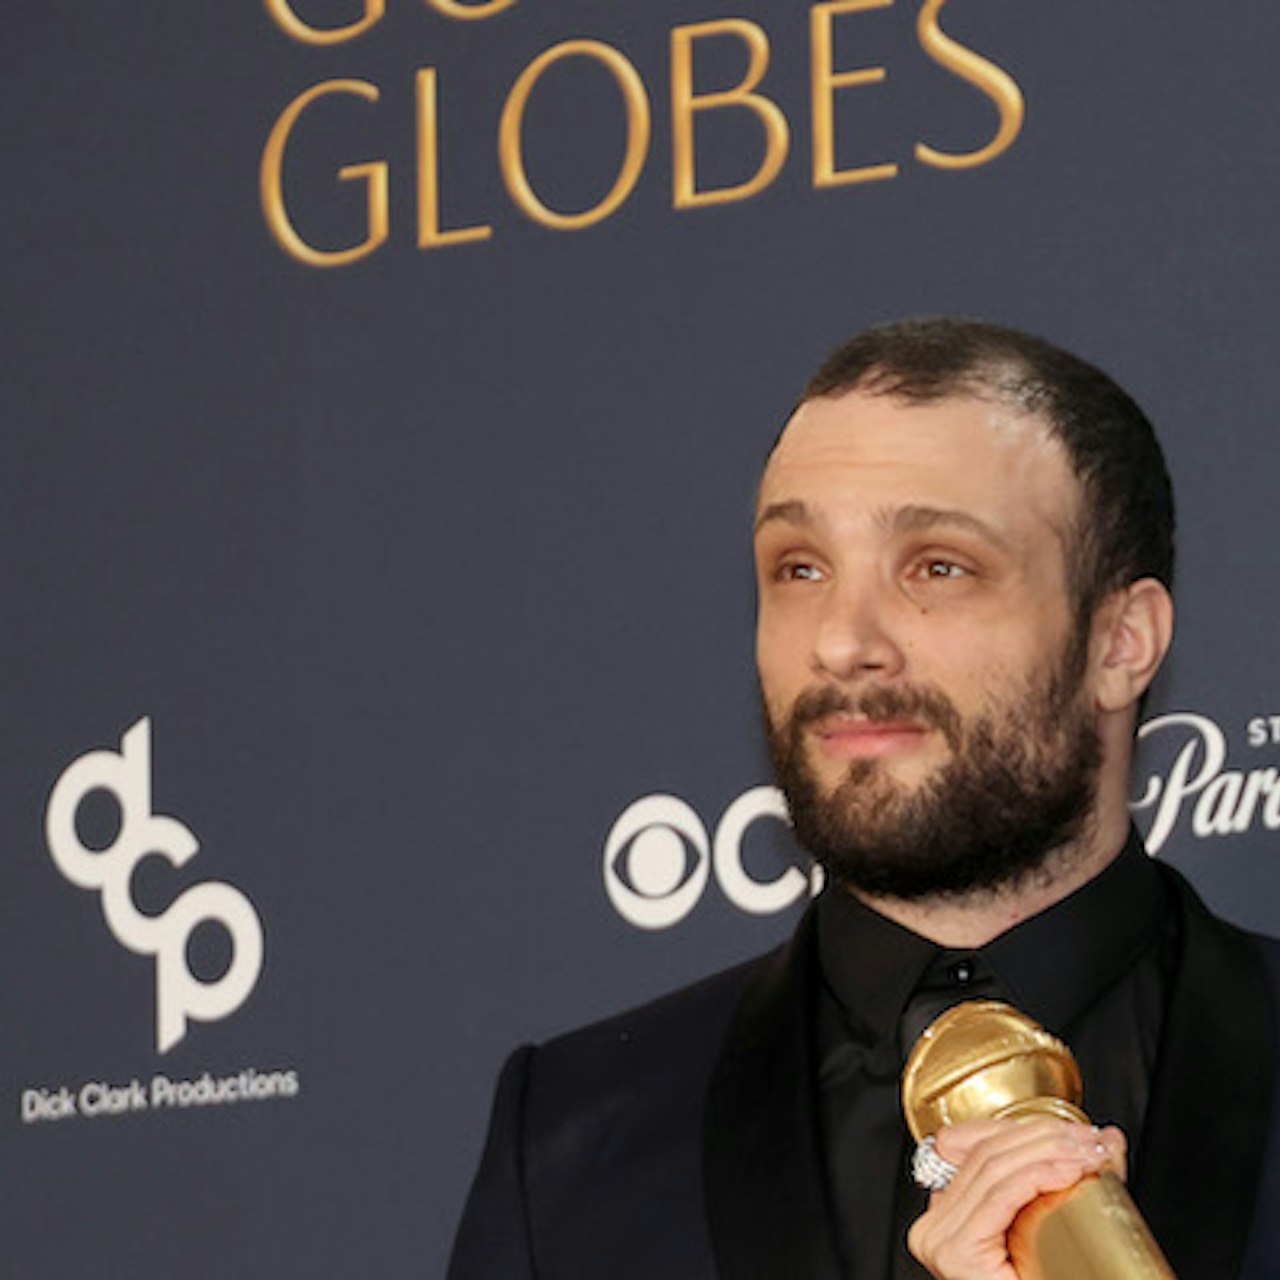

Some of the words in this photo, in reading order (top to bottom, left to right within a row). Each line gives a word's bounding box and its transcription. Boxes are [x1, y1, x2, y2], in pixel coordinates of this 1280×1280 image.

[259, 0, 1025, 267] GLOBES
[21, 1088, 76, 1123] Dick
[78, 1079, 148, 1117] Clark
[151, 1068, 300, 1108] Productions
